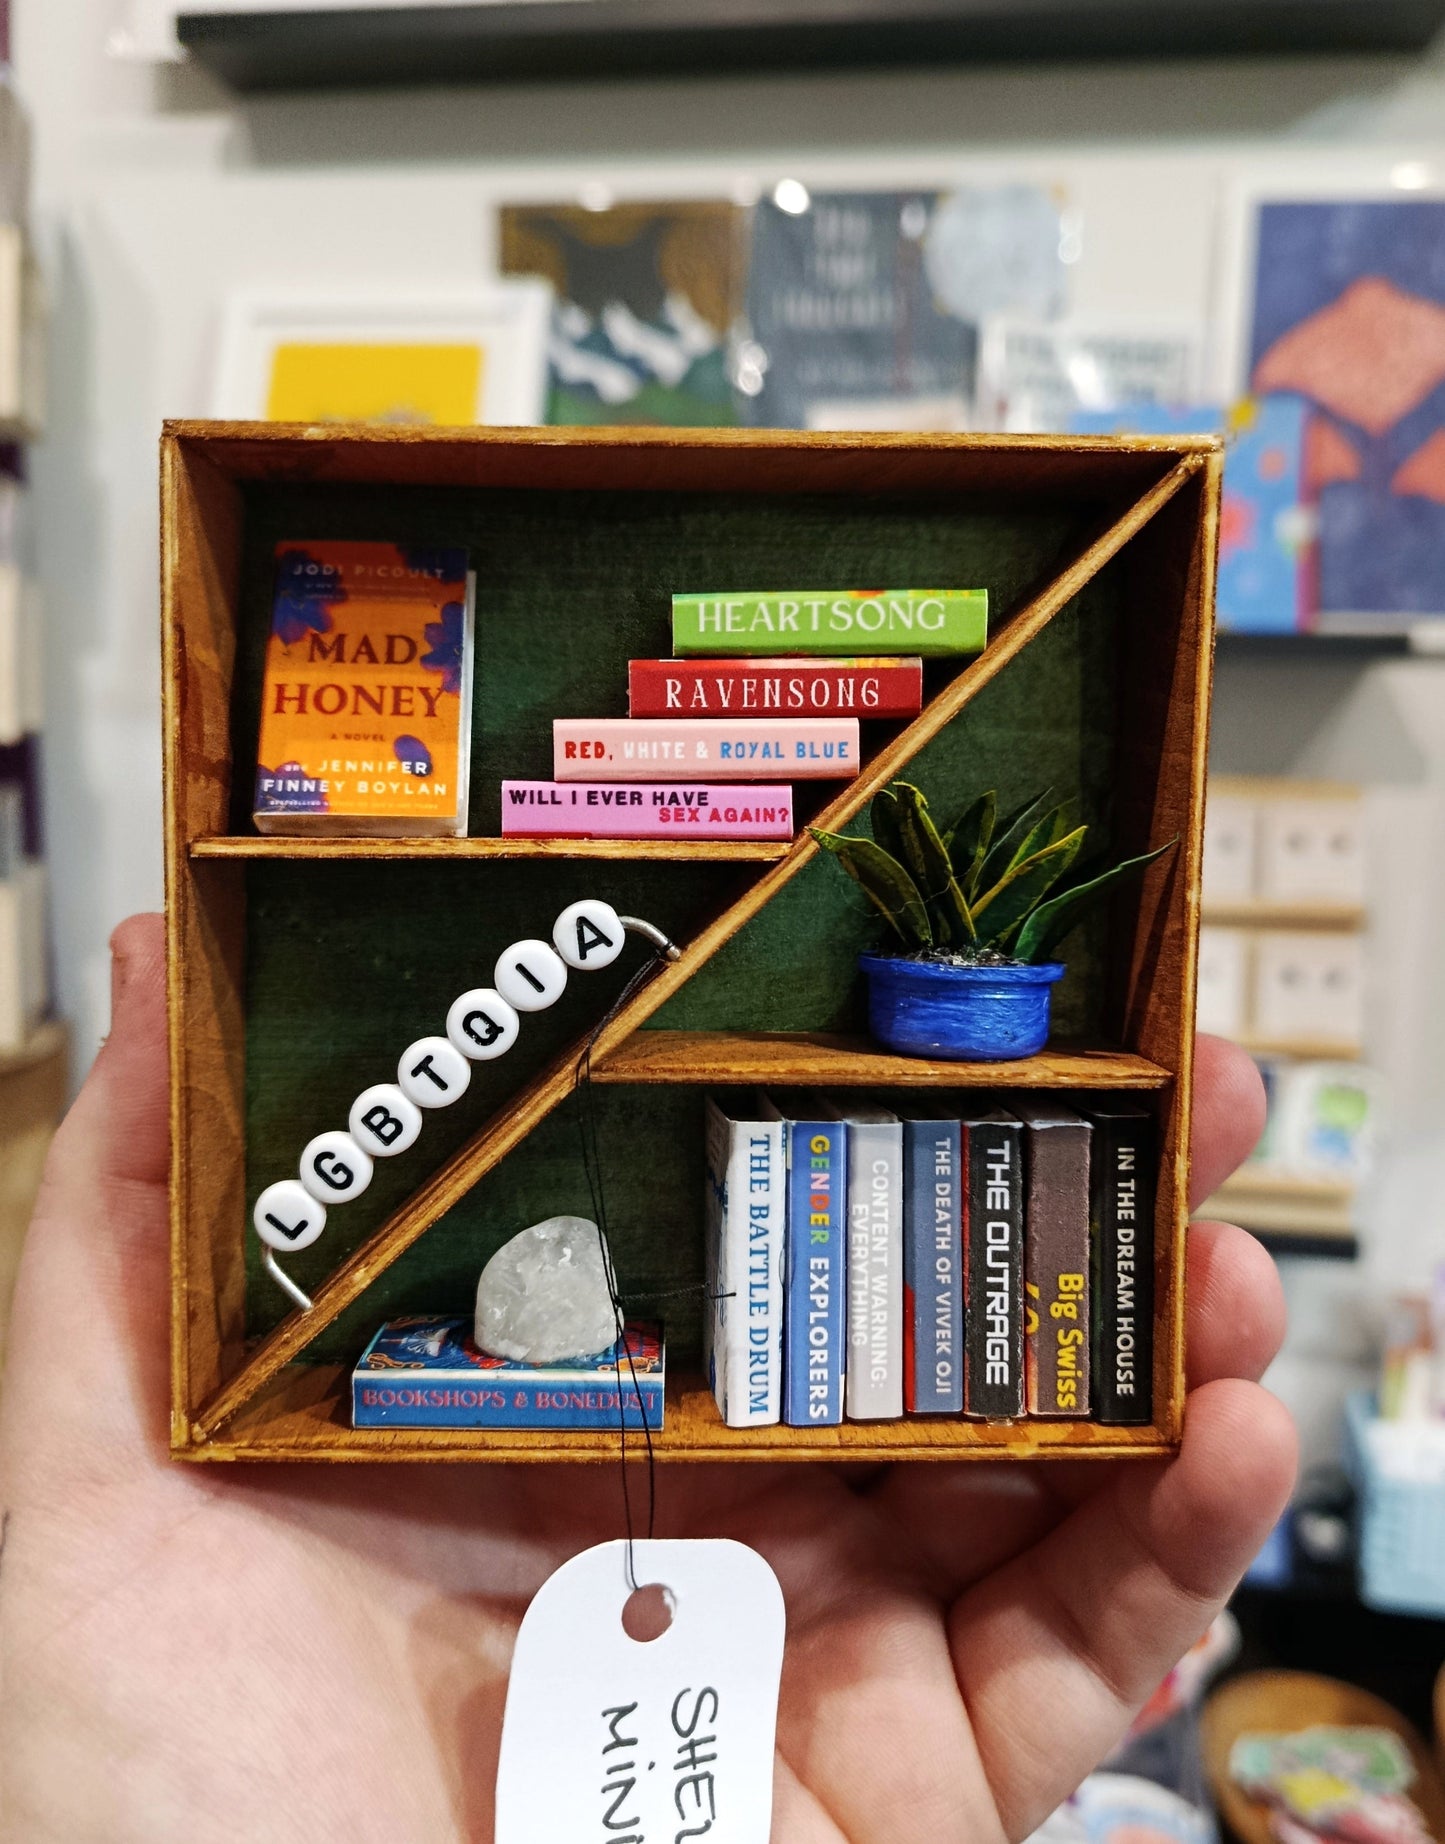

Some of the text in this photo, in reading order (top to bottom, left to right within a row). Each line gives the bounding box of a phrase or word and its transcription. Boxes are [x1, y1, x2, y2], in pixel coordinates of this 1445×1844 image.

[293, 564, 344, 576] JODI
[697, 599, 946, 633] HEARTSONG
[307, 633, 418, 665] MAD
[272, 683, 444, 717] HONEY
[665, 677, 880, 708] RAVENSONG
[344, 732, 386, 742] NOVEL
[564, 739, 849, 761] RED, WHITE & ROYAL BLUE
[317, 760, 429, 775] JENNIFER
[262, 778, 447, 796] FINNEY BOYLAN
[508, 789, 709, 806] WILL I EVER HAVE
[658, 807, 789, 823] SEX AGAIN?
[749, 1134, 770, 1415] THE BATTLE DRUM
[809, 1134, 831, 1420] GENDER EXPLORERS
[851, 1203, 869, 1347] EVERYTHING
[870, 1159, 889, 1389] CONTENT WARNING:
[935, 1137, 952, 1394] THE DEATH OF VIVEK OJI
[985, 1140, 1010, 1385] THE OUTRAGE
[1116, 1147, 1135, 1397] IN THE DREAM HOUSE
[1050, 1273, 1084, 1408] Big Swiss
[363, 1389, 658, 1410] BOOKSHOPS & BONEDUST
